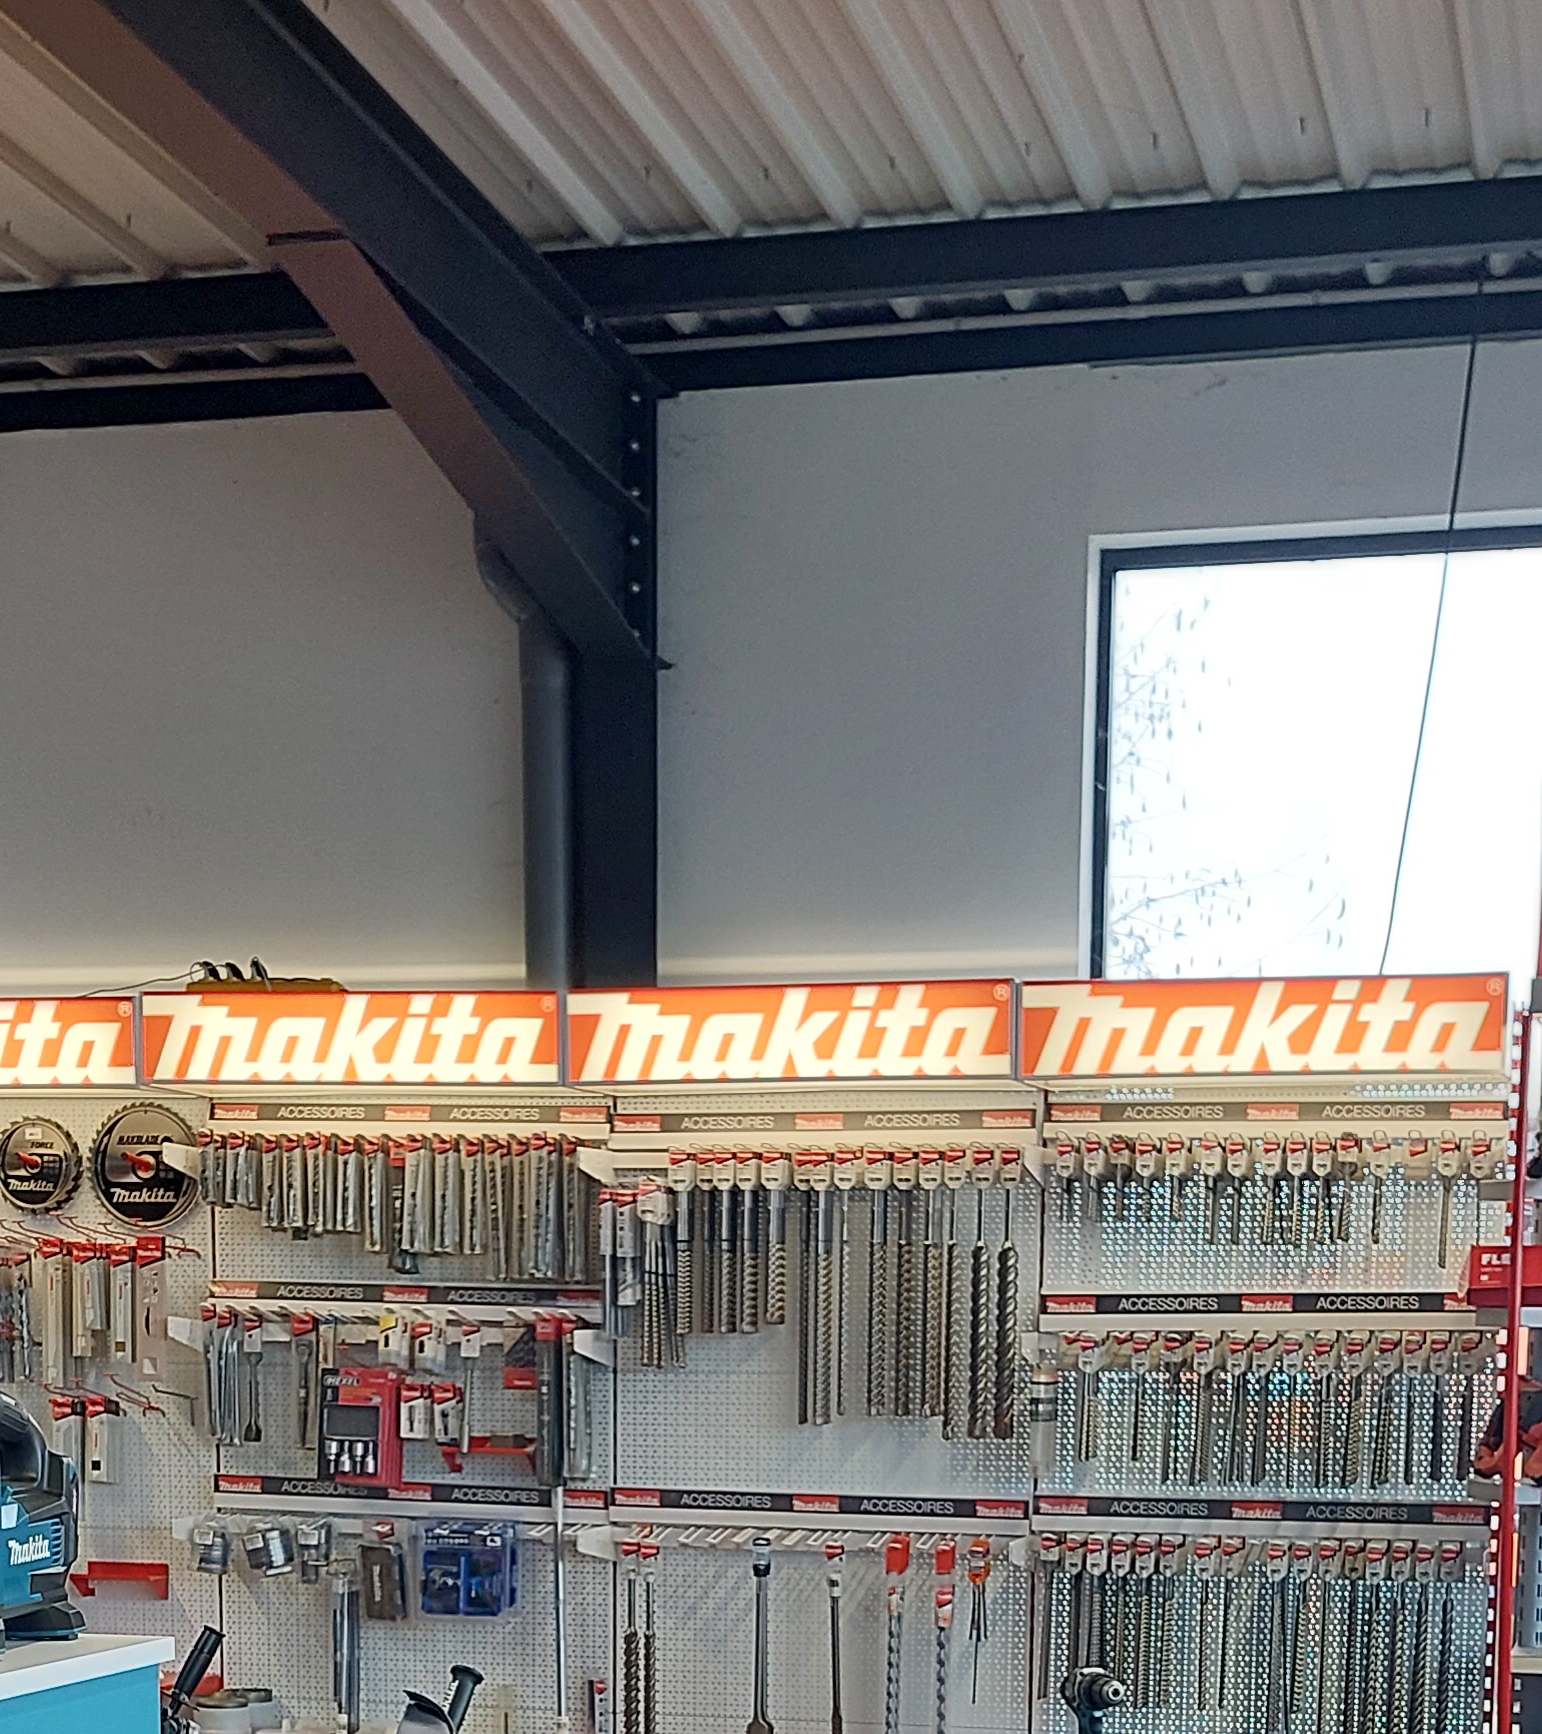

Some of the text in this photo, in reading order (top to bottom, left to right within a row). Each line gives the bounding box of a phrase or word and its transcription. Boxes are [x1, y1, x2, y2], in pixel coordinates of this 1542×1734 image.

[570, 985, 1008, 1083] Makita
[1033, 978, 1504, 1079] Makita
[142, 994, 560, 1083] Makita
[277, 1107, 539, 1121] ACCESSOIRES ACCESSOIRES
[1123, 1105, 1425, 1119] ACCESSOIRES ACCESSOIRES
[681, 1114, 959, 1129] ACCESSOIRES ACCESSOIRES
[7, 1179, 55, 1192] Makita
[111, 1188, 177, 1203] Makita
[1481, 1253, 1511, 1266] FLE
[276, 1285, 364, 1300] ACCESSOIRES
[1118, 1296, 1419, 1311] ACCESSOIRES ACCESSOIRES
[451, 1488, 540, 1503] ACCESSOIRES
[681, 1494, 955, 1515] ACCESSOIRES ACCESSOIRES
[1110, 1502, 1407, 1520] ACCESSOIRES ACCESSOIRES
[8, 1534, 50, 1565] Makita
